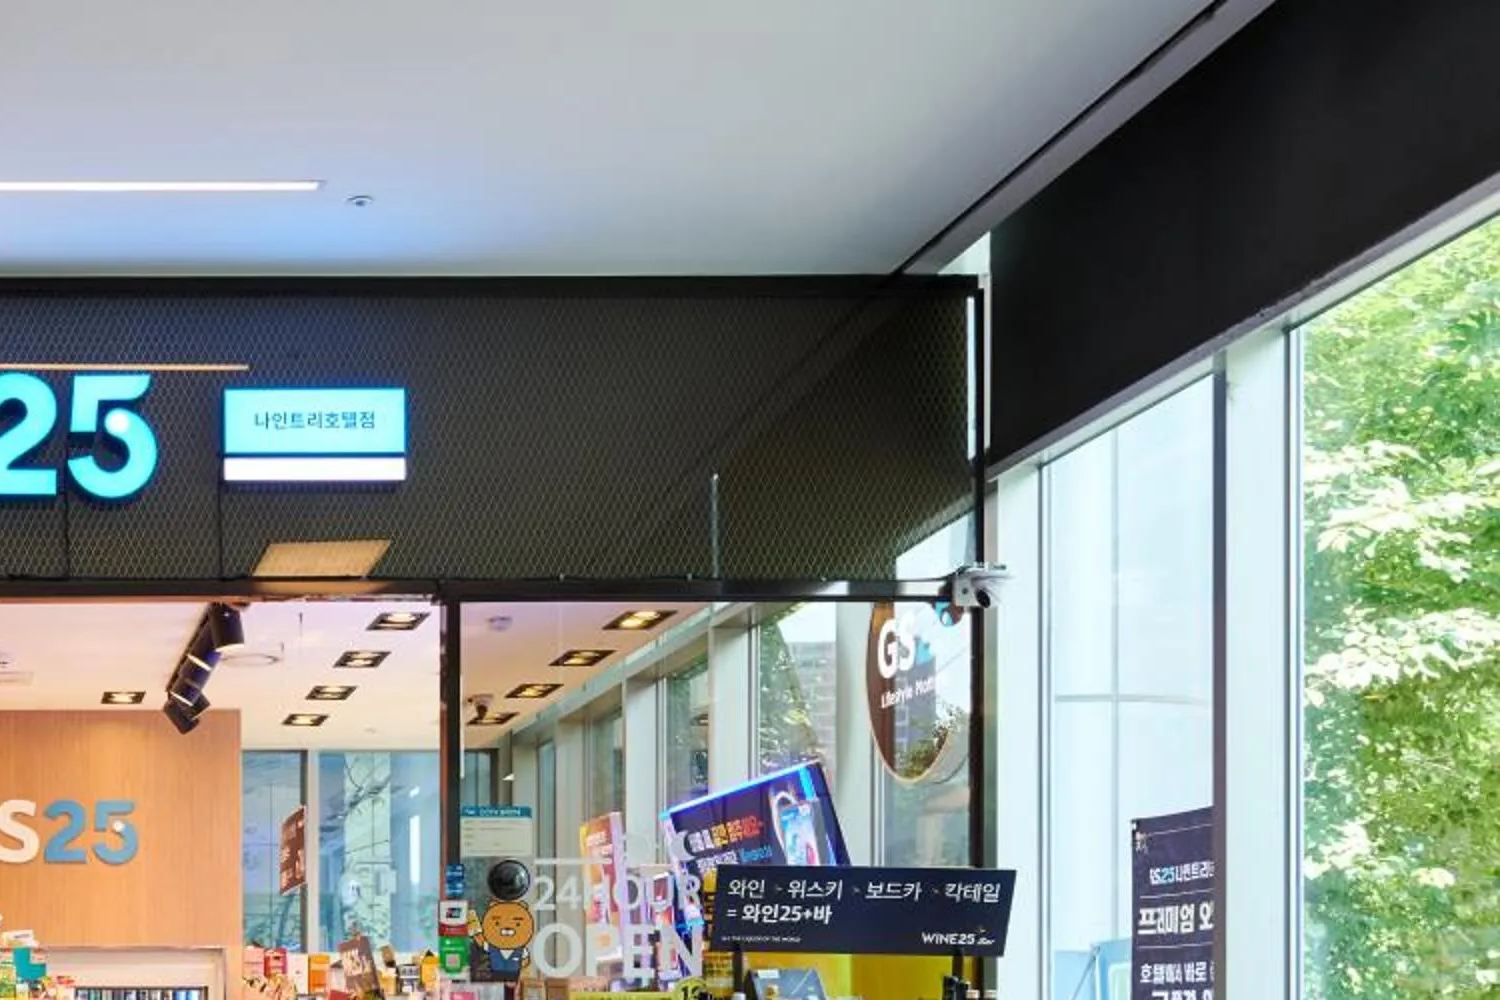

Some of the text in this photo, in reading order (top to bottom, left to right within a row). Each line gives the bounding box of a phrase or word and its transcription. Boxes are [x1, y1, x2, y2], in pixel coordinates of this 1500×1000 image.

[255, 410, 375, 430] 나인트리호텔점
[533, 875, 700, 913] 24HOUR
[727, 879, 1001, 903] 와인 위스키 보드카 칵테일
[742, 904, 833, 924] 와인25+바
[1138, 903, 1194, 934] 프리미엄
[921, 931, 976, 945] WINE25
[533, 923, 702, 979] OPEN
